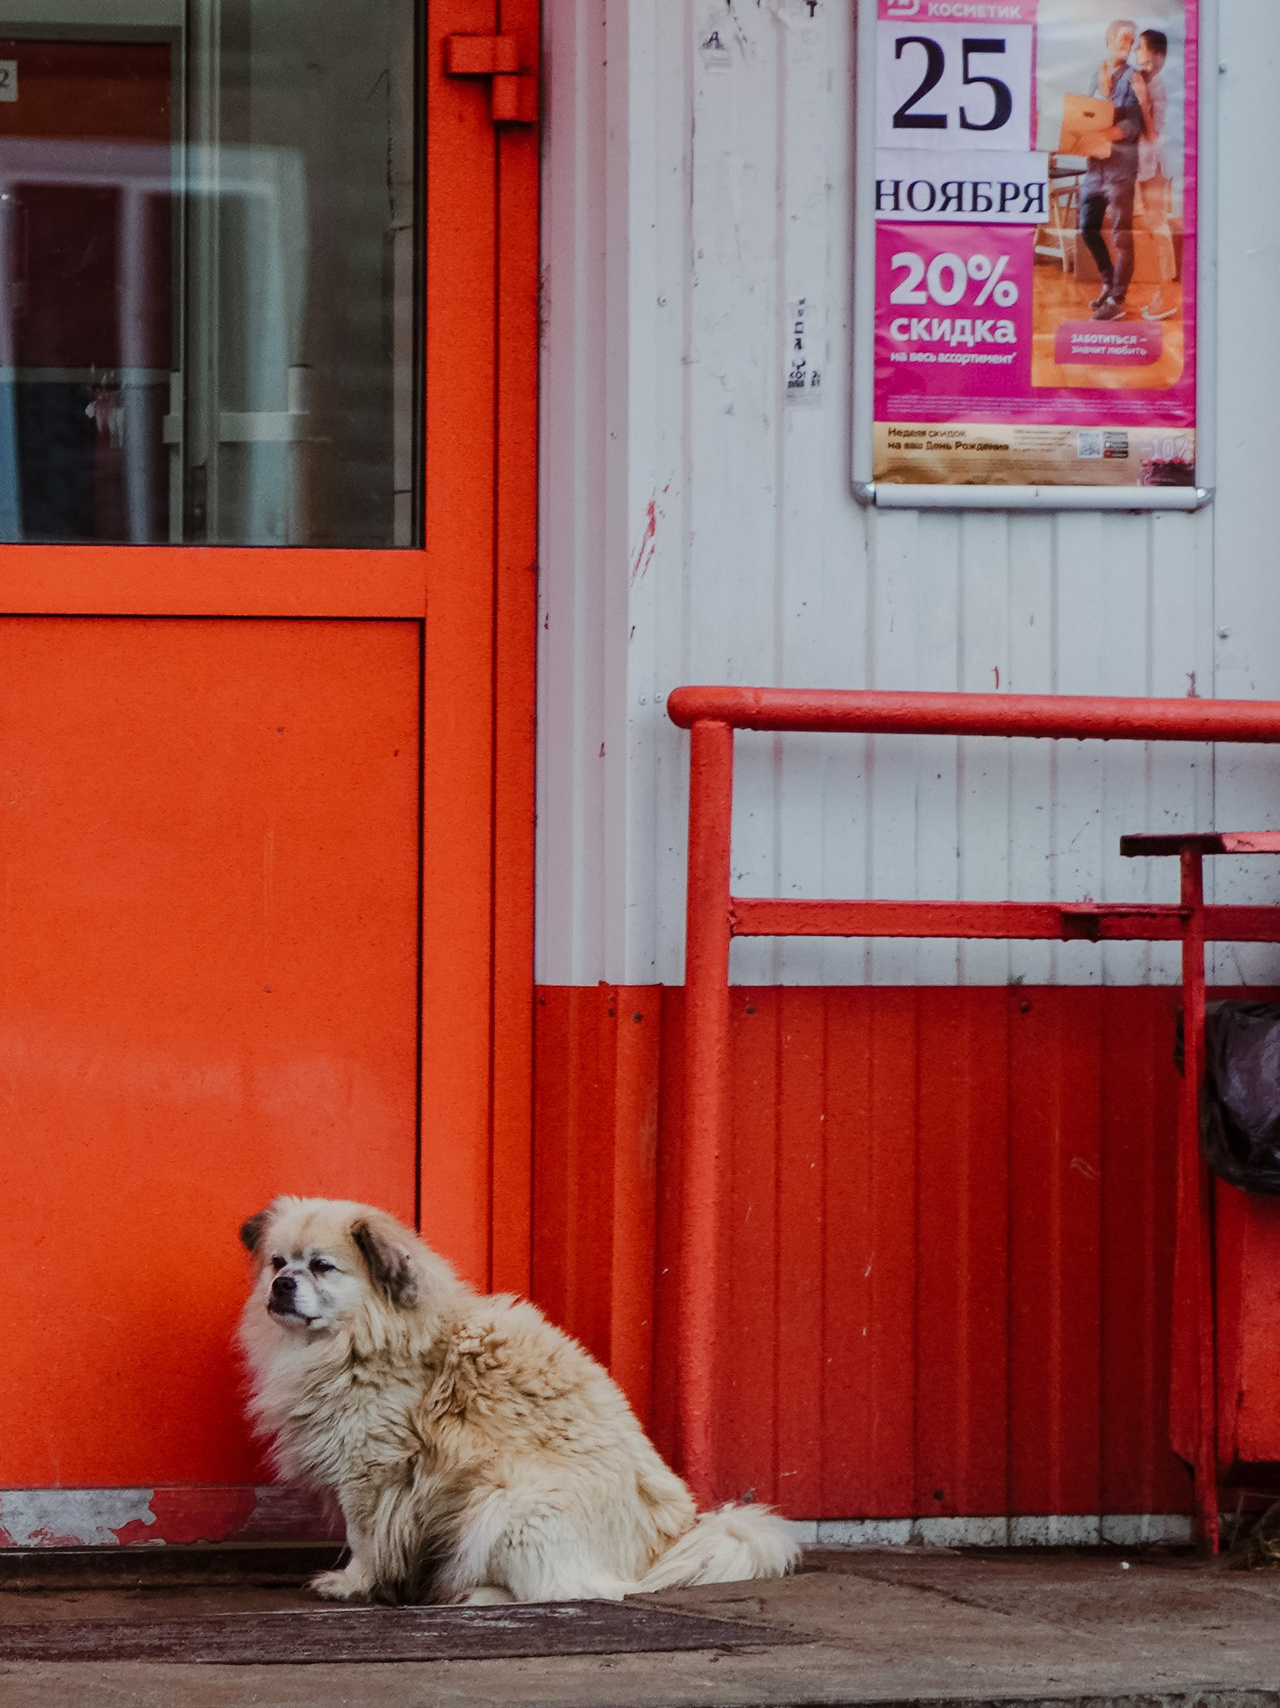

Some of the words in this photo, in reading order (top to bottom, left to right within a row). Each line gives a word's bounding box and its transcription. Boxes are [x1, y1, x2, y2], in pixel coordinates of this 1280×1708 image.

[927, 3, 1022, 18] КОСМЕТИК
[892, 35, 1013, 131] 25
[874, 179, 1047, 216] НОЯБРЯ
[889, 251, 1019, 308] 20%
[889, 316, 1017, 347] скидка
[890, 352, 908, 363] на
[909, 352, 937, 363] весь
